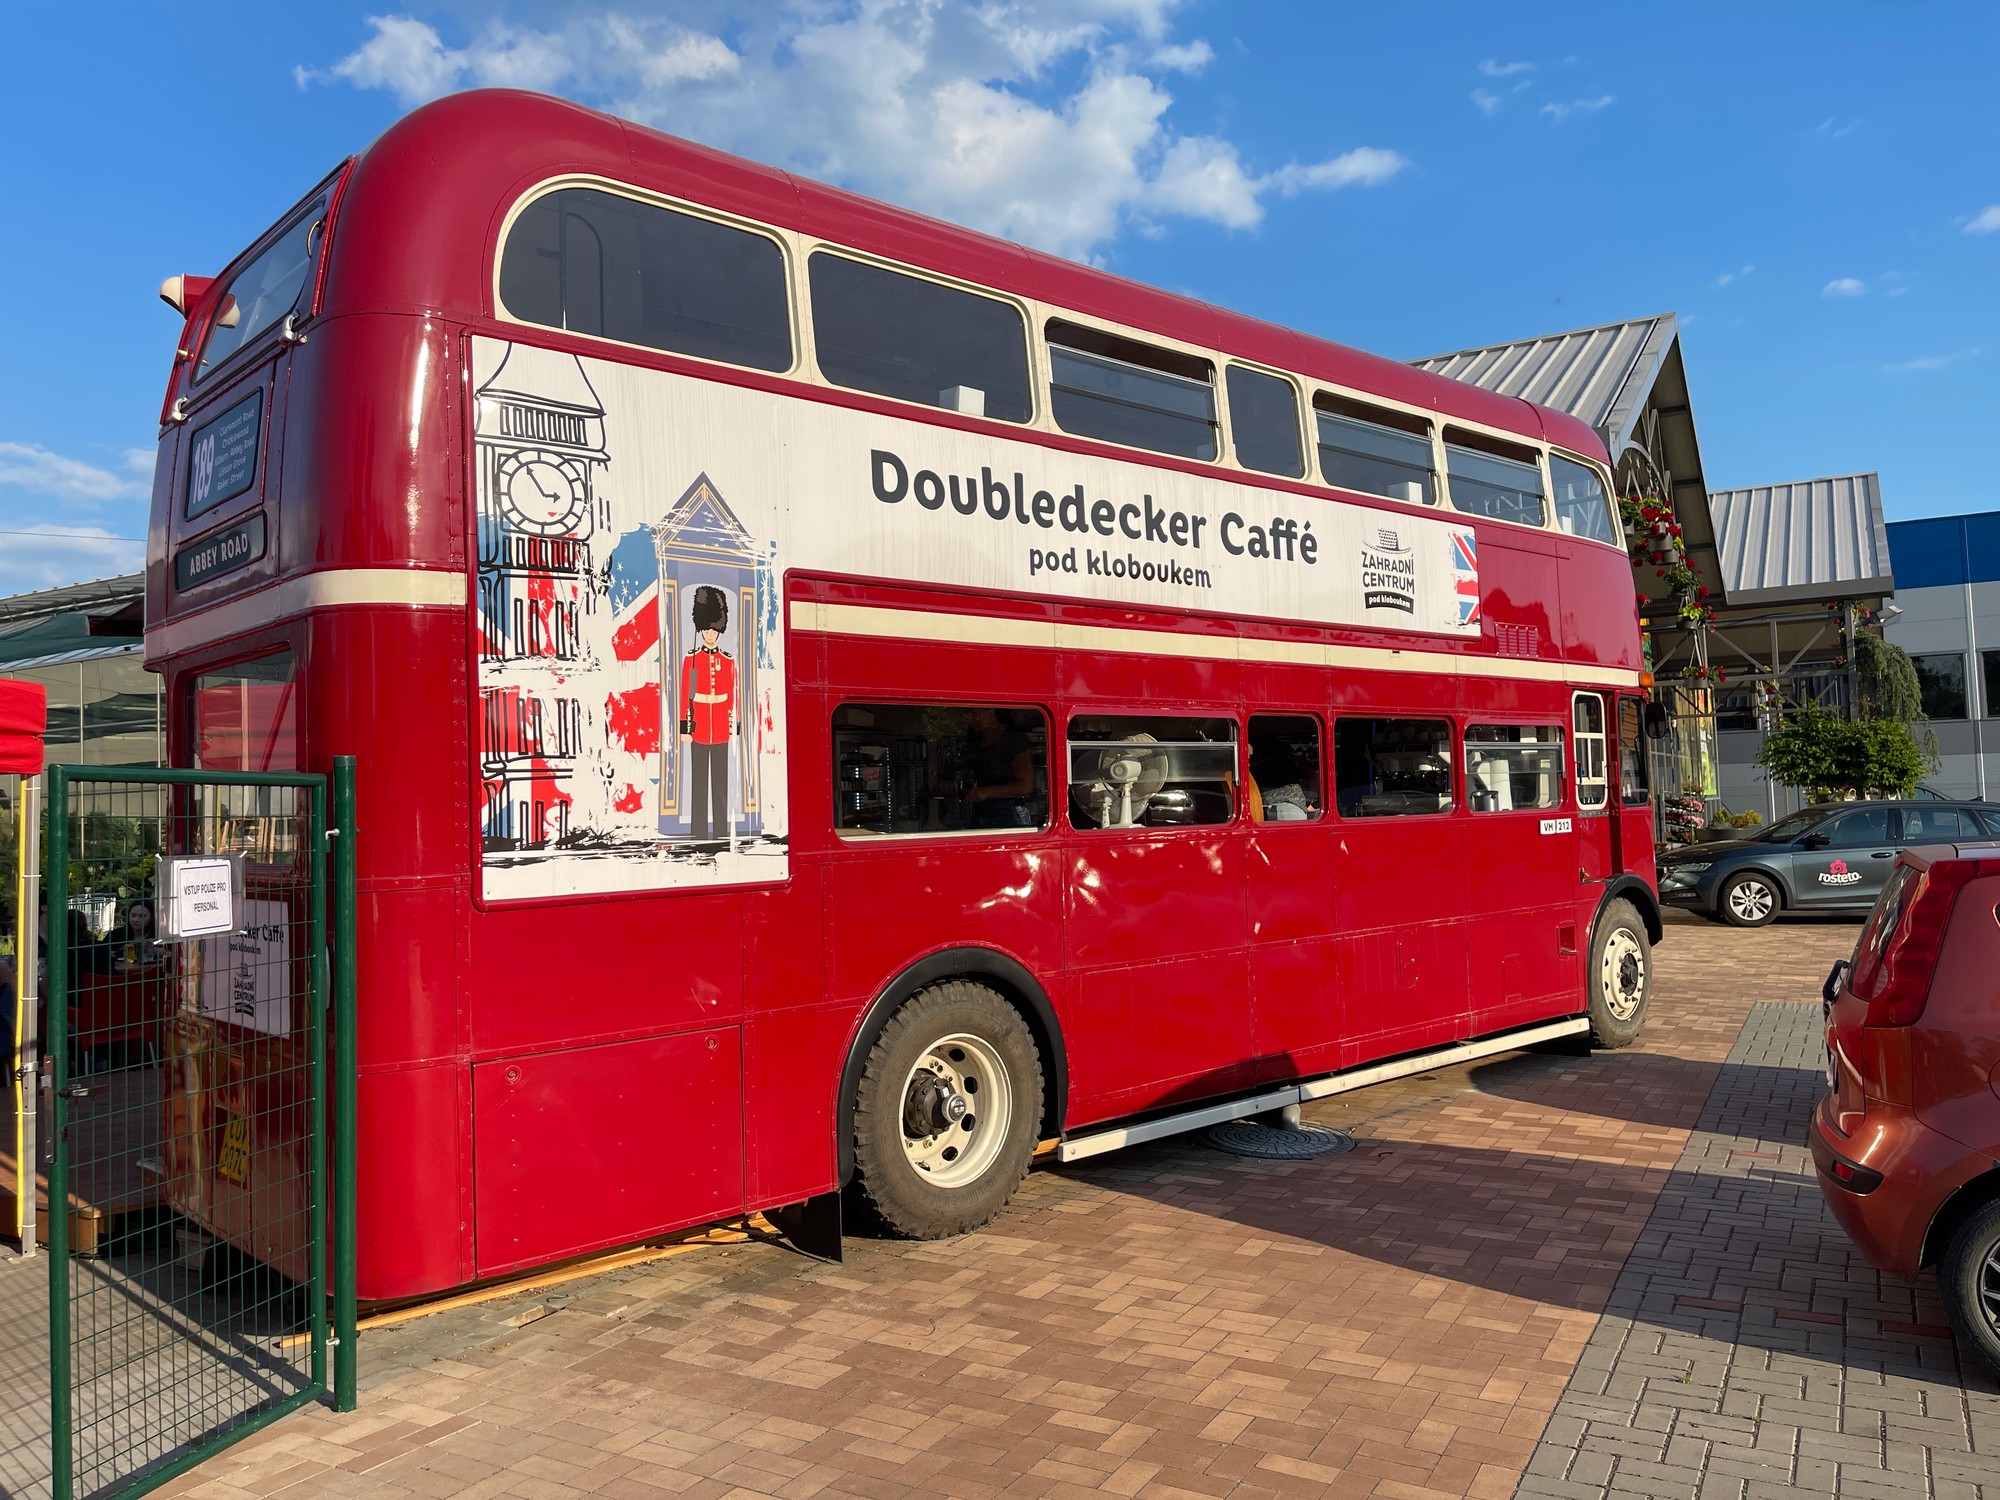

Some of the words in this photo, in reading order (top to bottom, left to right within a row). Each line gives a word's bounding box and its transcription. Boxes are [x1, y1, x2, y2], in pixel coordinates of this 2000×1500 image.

[242, 407, 255, 422] Road
[230, 443, 244, 457] Abbey
[243, 434, 255, 450] Road
[192, 433, 215, 505] 189
[232, 455, 247, 469] Grove
[230, 468, 245, 485] Street
[870, 448, 1207, 550] Doubledecker
[1219, 510, 1319, 566] Caffé
[189, 544, 218, 577] ABBEY
[221, 532, 249, 562] ROAD
[1361, 550, 1415, 576] ZAHRADNÍ
[1029, 546, 1079, 577] pod
[1086, 548, 1213, 590] kloboukem
[1362, 571, 1416, 595] CENTRUM
[1368, 594, 1380, 605] pod
[1381, 594, 1411, 608] kloboukem
[1558, 821, 1570, 831] 212
[183, 884, 201, 896] VSTUP
[200, 882, 217, 894] POUZE
[216, 881, 227, 893] PRO
